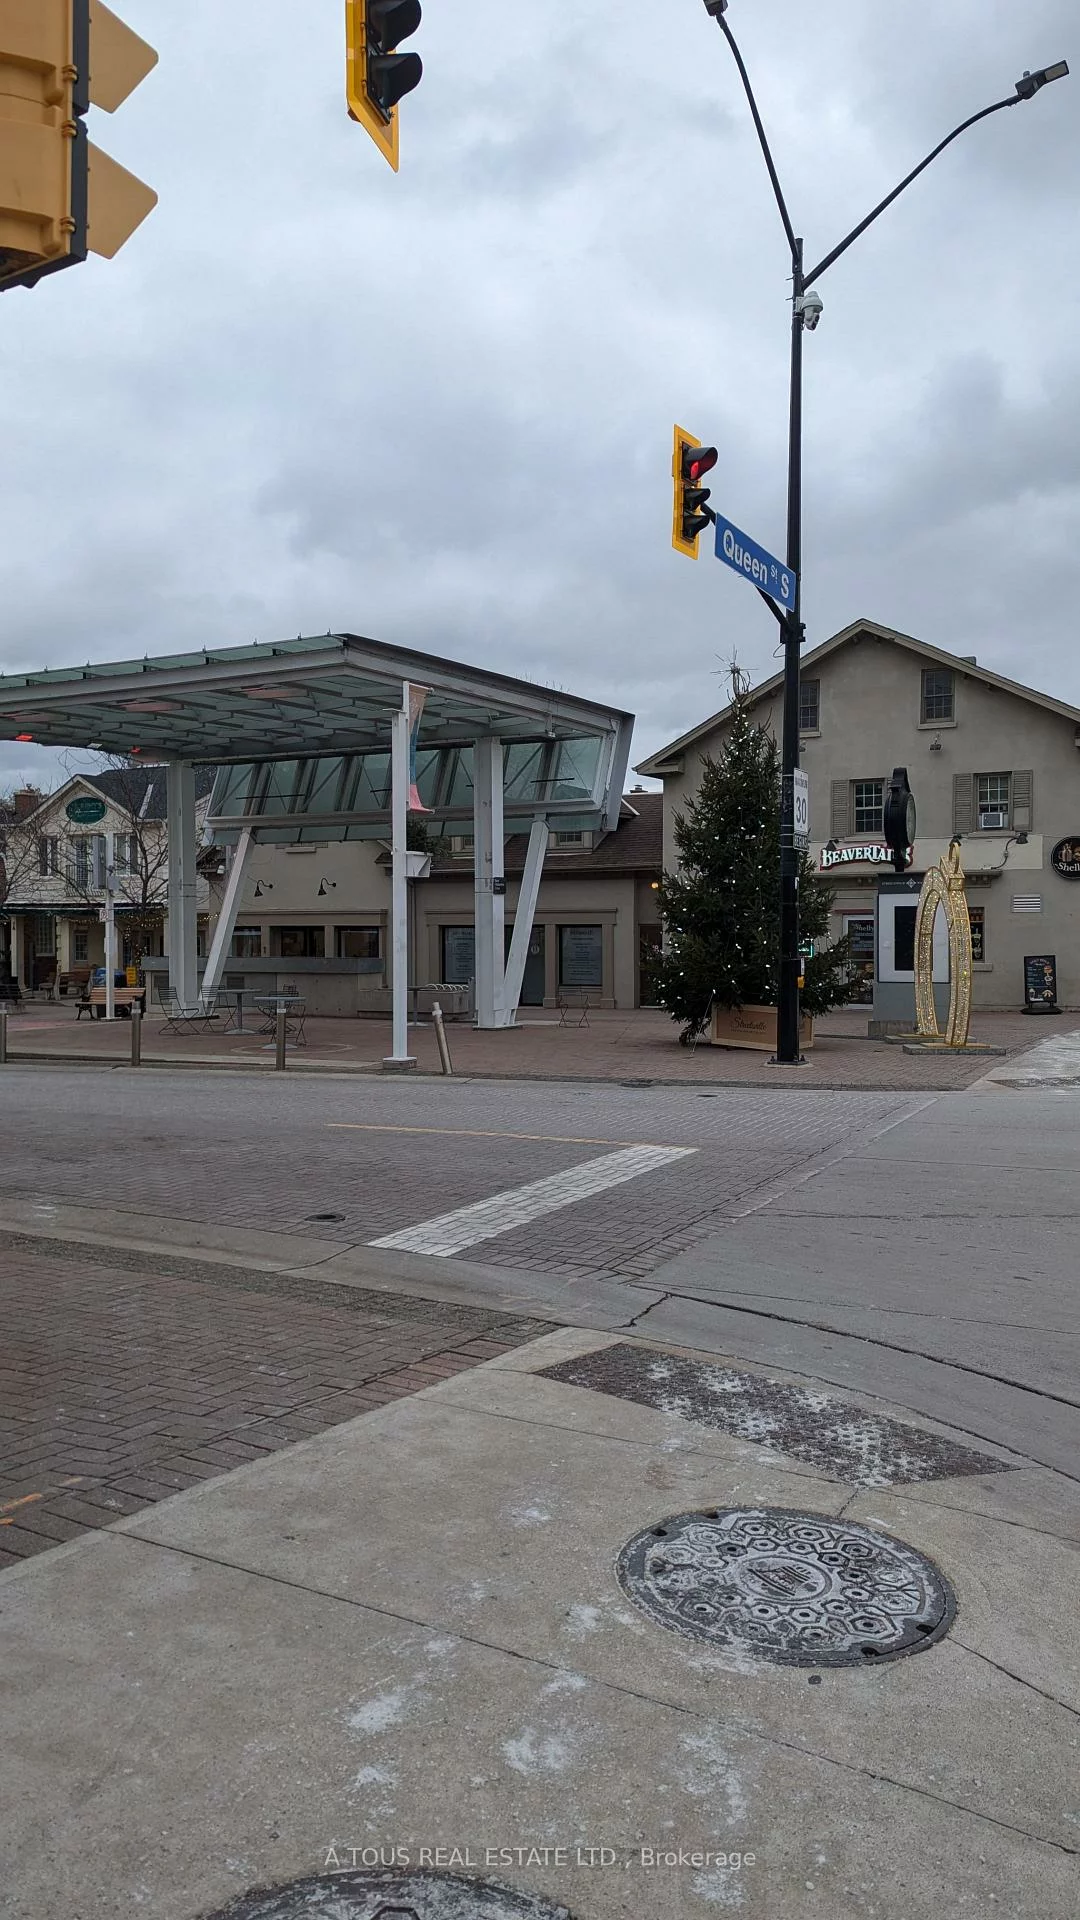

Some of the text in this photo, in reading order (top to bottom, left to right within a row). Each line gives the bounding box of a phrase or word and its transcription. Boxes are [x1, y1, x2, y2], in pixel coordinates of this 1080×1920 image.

[723, 529, 789, 598] Queen St S
[796, 796, 806, 824] 30
